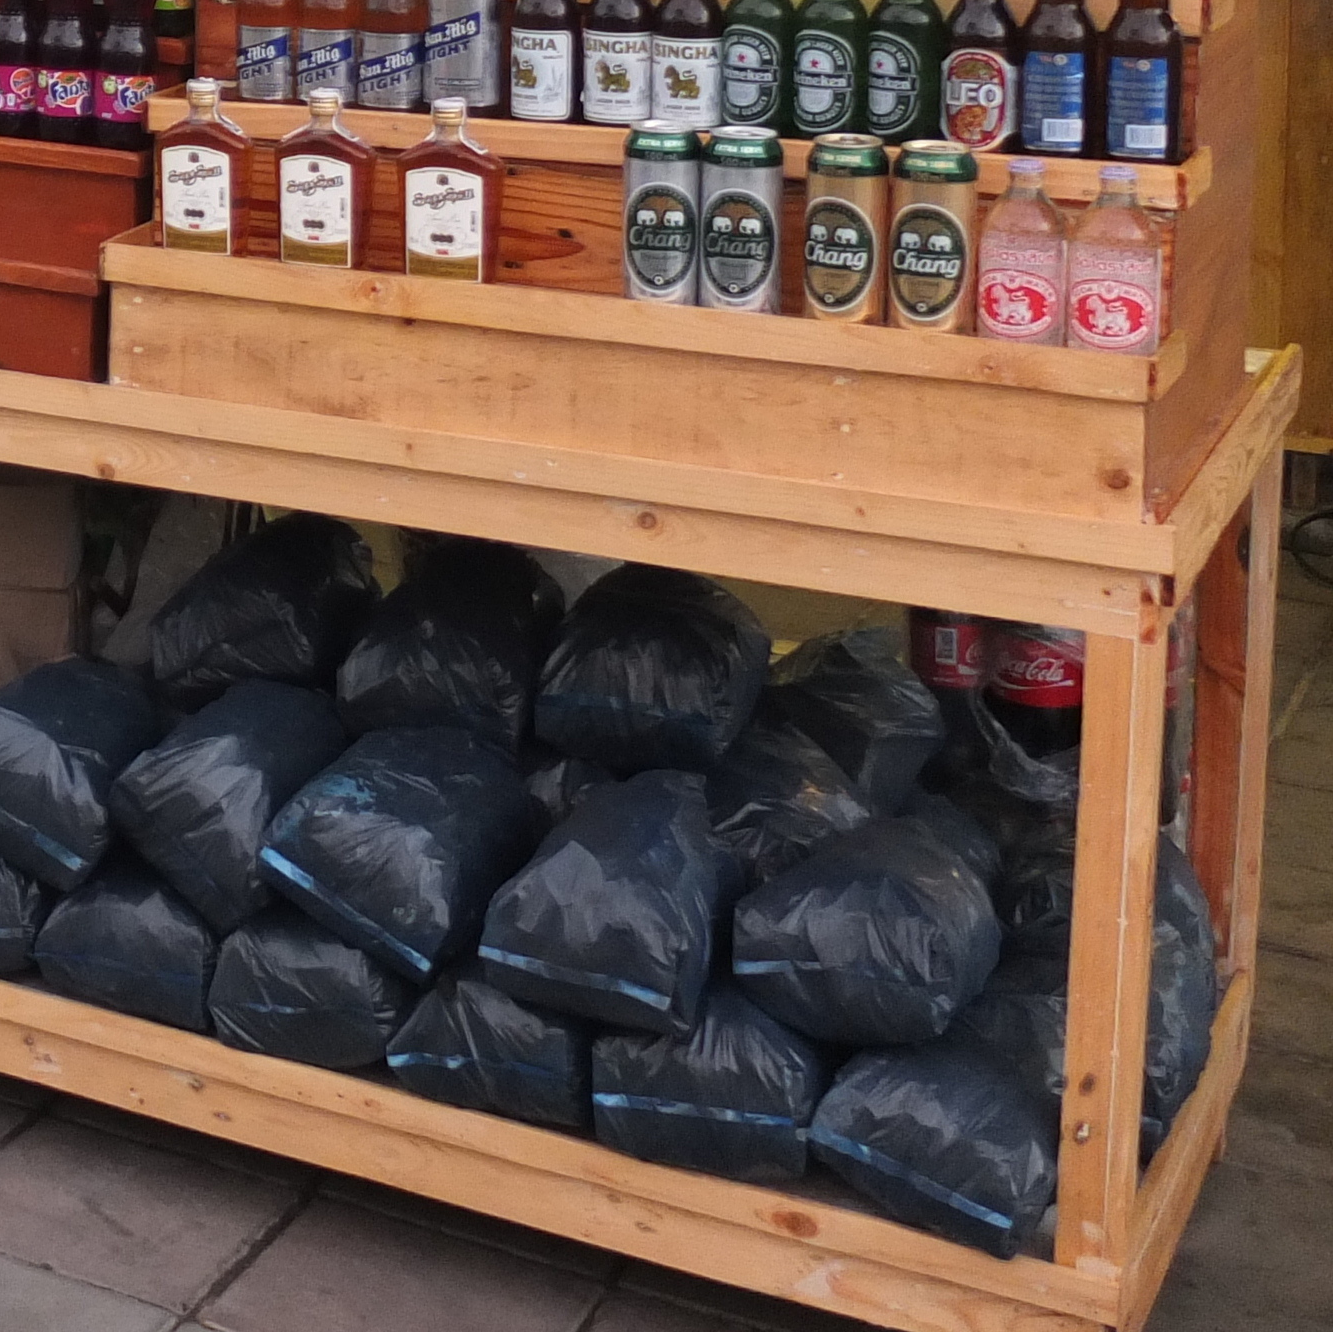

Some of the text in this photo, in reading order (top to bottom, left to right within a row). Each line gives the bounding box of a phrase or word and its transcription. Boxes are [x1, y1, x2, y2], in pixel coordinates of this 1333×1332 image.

[583, 40, 649, 55] SINGHA
[654, 44, 719, 60] SINGHA
[49, 78, 90, 101] Fanta
[361, 70, 413, 94] LIGHT
[946, 79, 1003, 106] LEO
[119, 82, 156, 109] Fant
[629, 225, 692, 251] Chang
[705, 232, 769, 260] Chang
[804, 240, 868, 271] Chang
[893, 249, 961, 278] Chang
